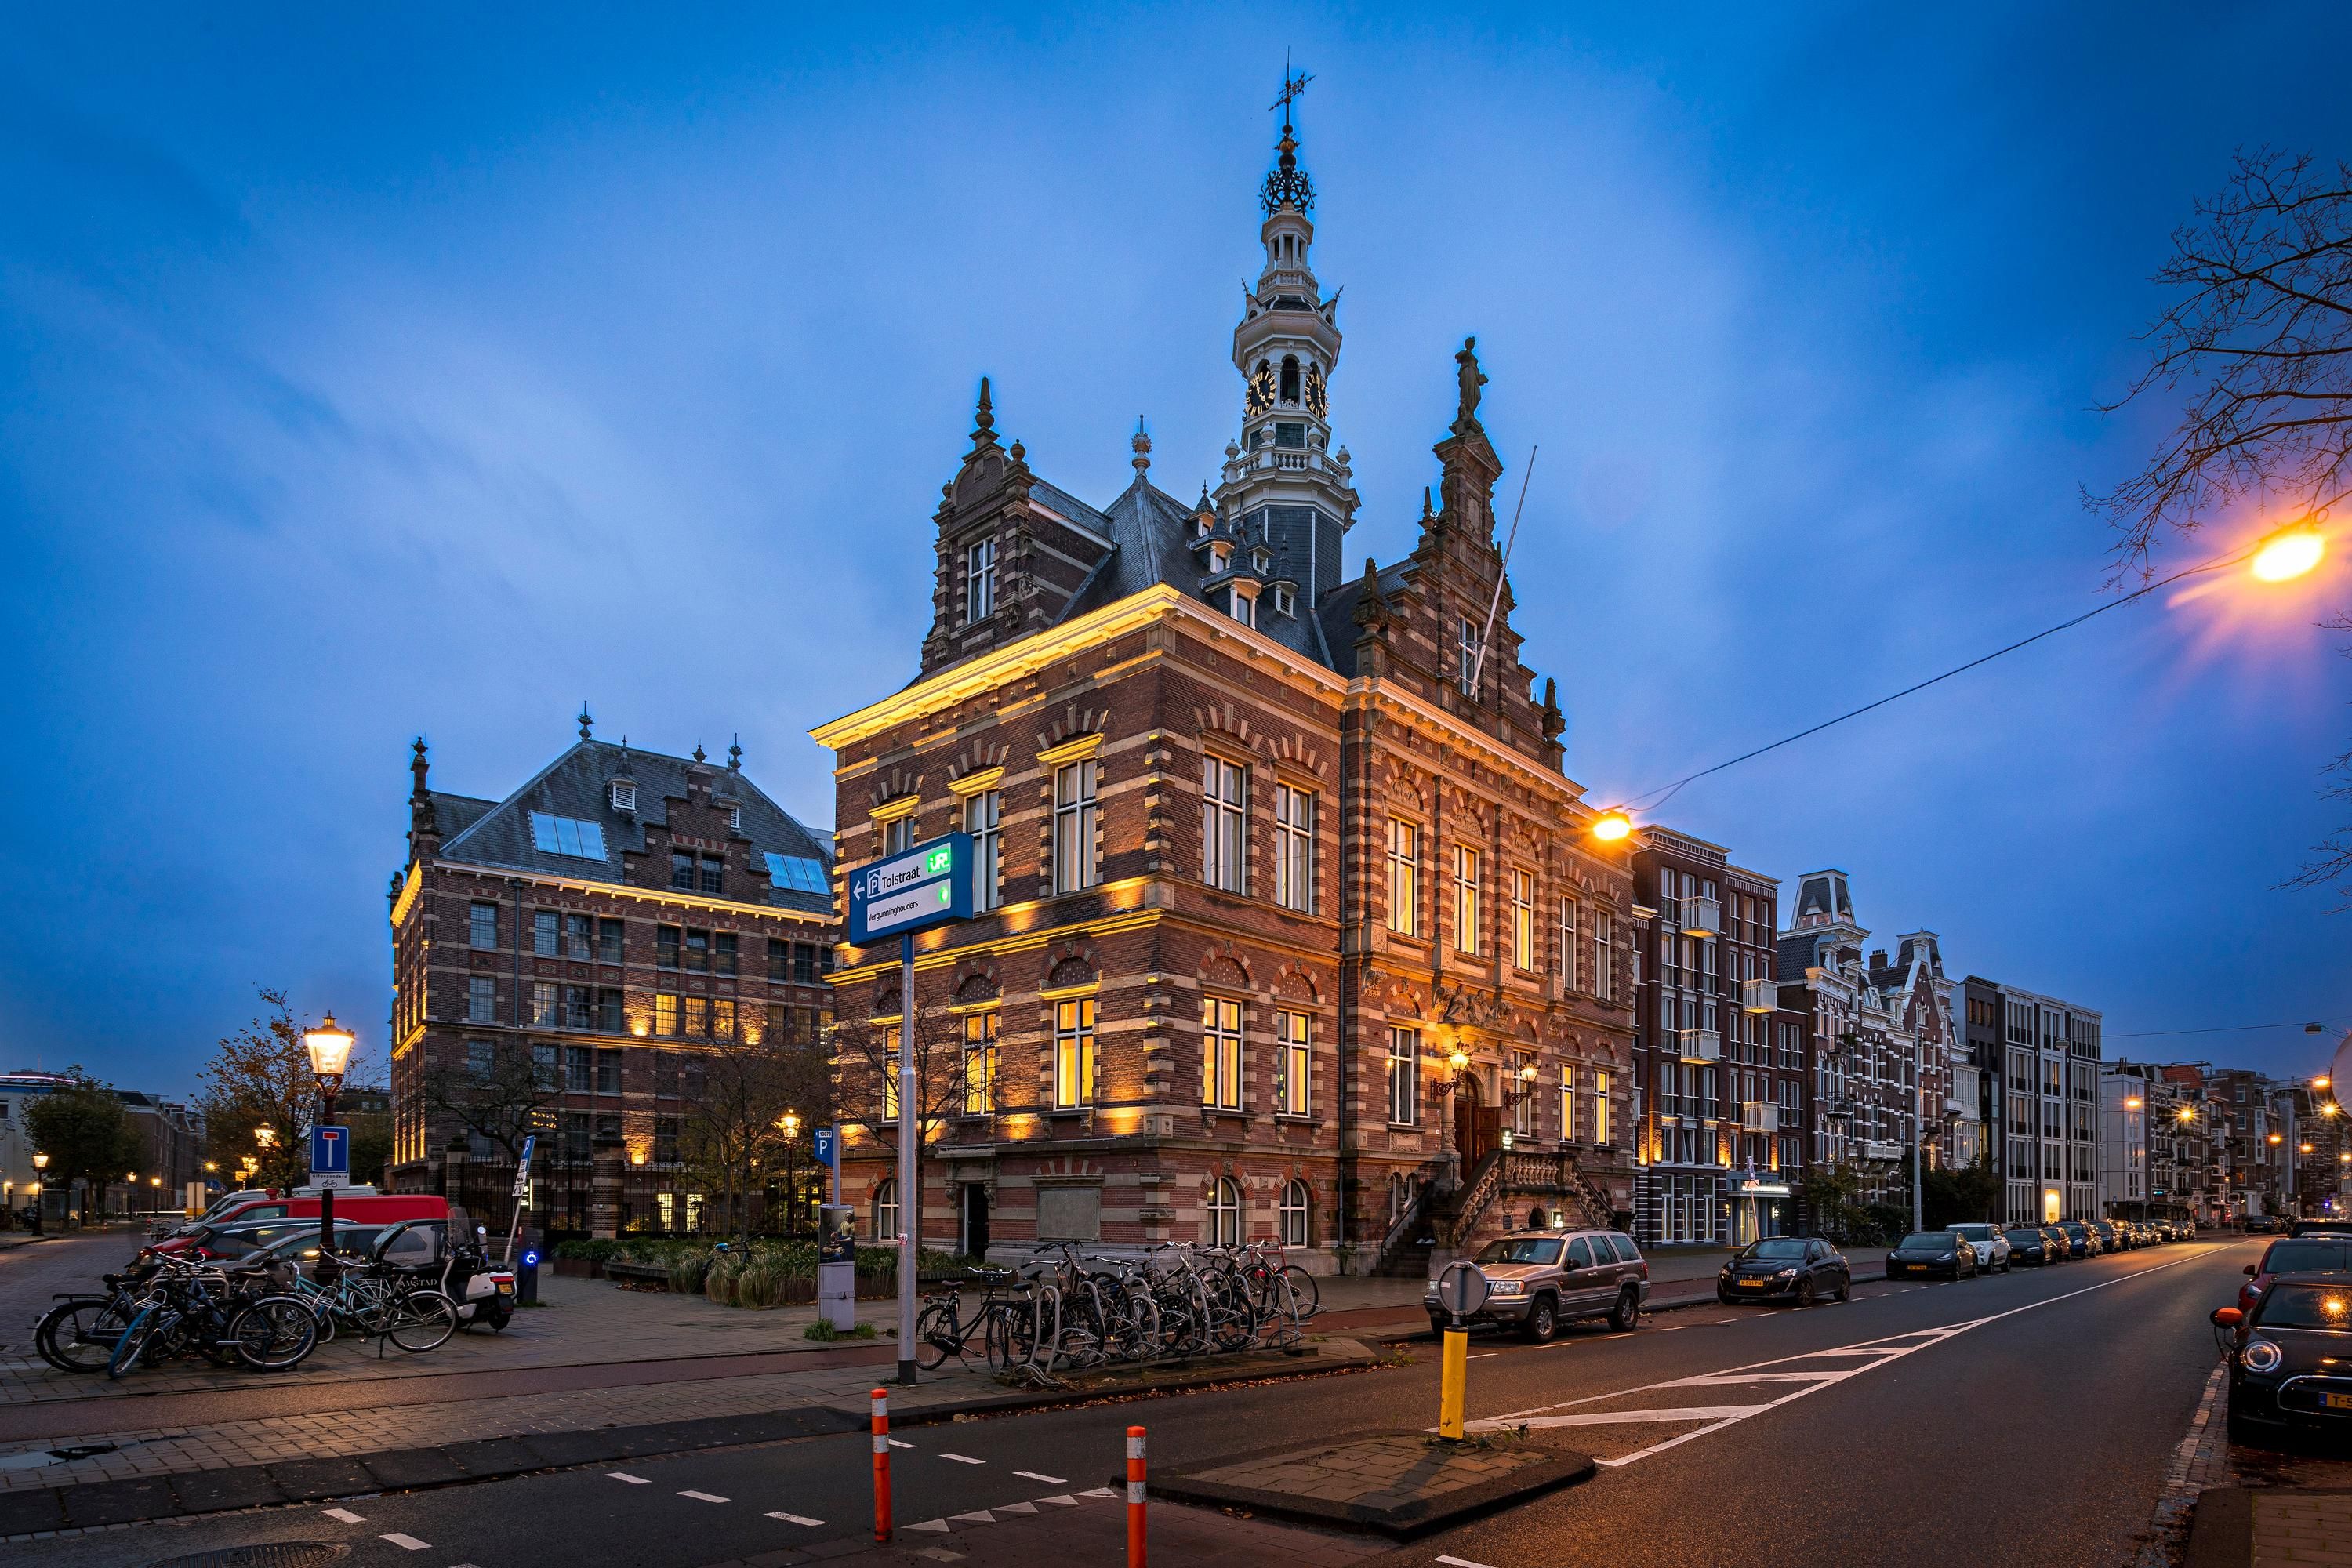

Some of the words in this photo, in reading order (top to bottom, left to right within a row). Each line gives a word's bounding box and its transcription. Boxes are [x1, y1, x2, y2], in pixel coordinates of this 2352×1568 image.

[881, 866, 920, 889] Tolstraat
[868, 901, 919, 922] Vergunninghouders
[523, 1139, 531, 1157] P
[819, 1139, 828, 1155] P
